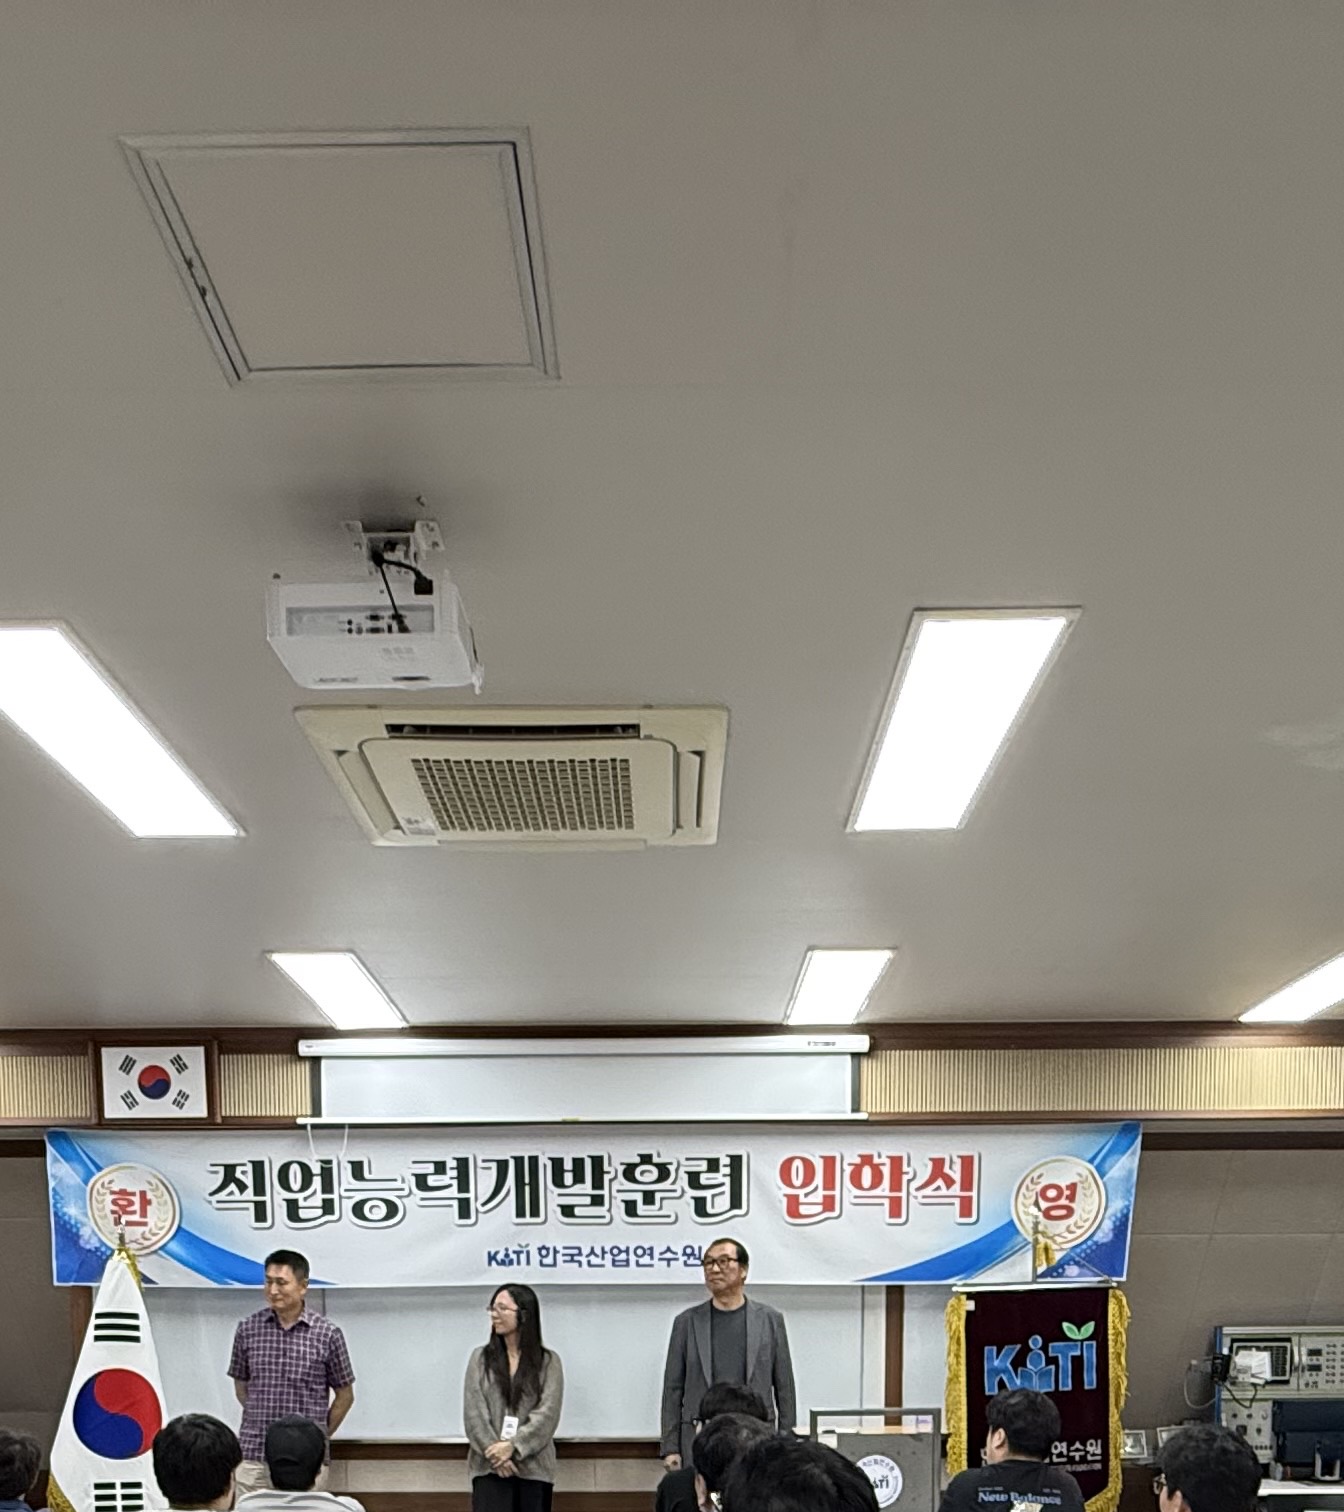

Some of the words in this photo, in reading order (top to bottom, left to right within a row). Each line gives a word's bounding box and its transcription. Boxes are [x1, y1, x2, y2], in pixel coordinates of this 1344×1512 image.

[109, 1187, 152, 1228] 환
[207, 1153, 744, 1224] 직업능력개발훈련
[778, 1153, 975, 1220] 입학식
[1038, 1181, 1078, 1221] 영
[537, 1244, 704, 1268] 한국산업연수원
[977, 1491, 1008, 1503] New
